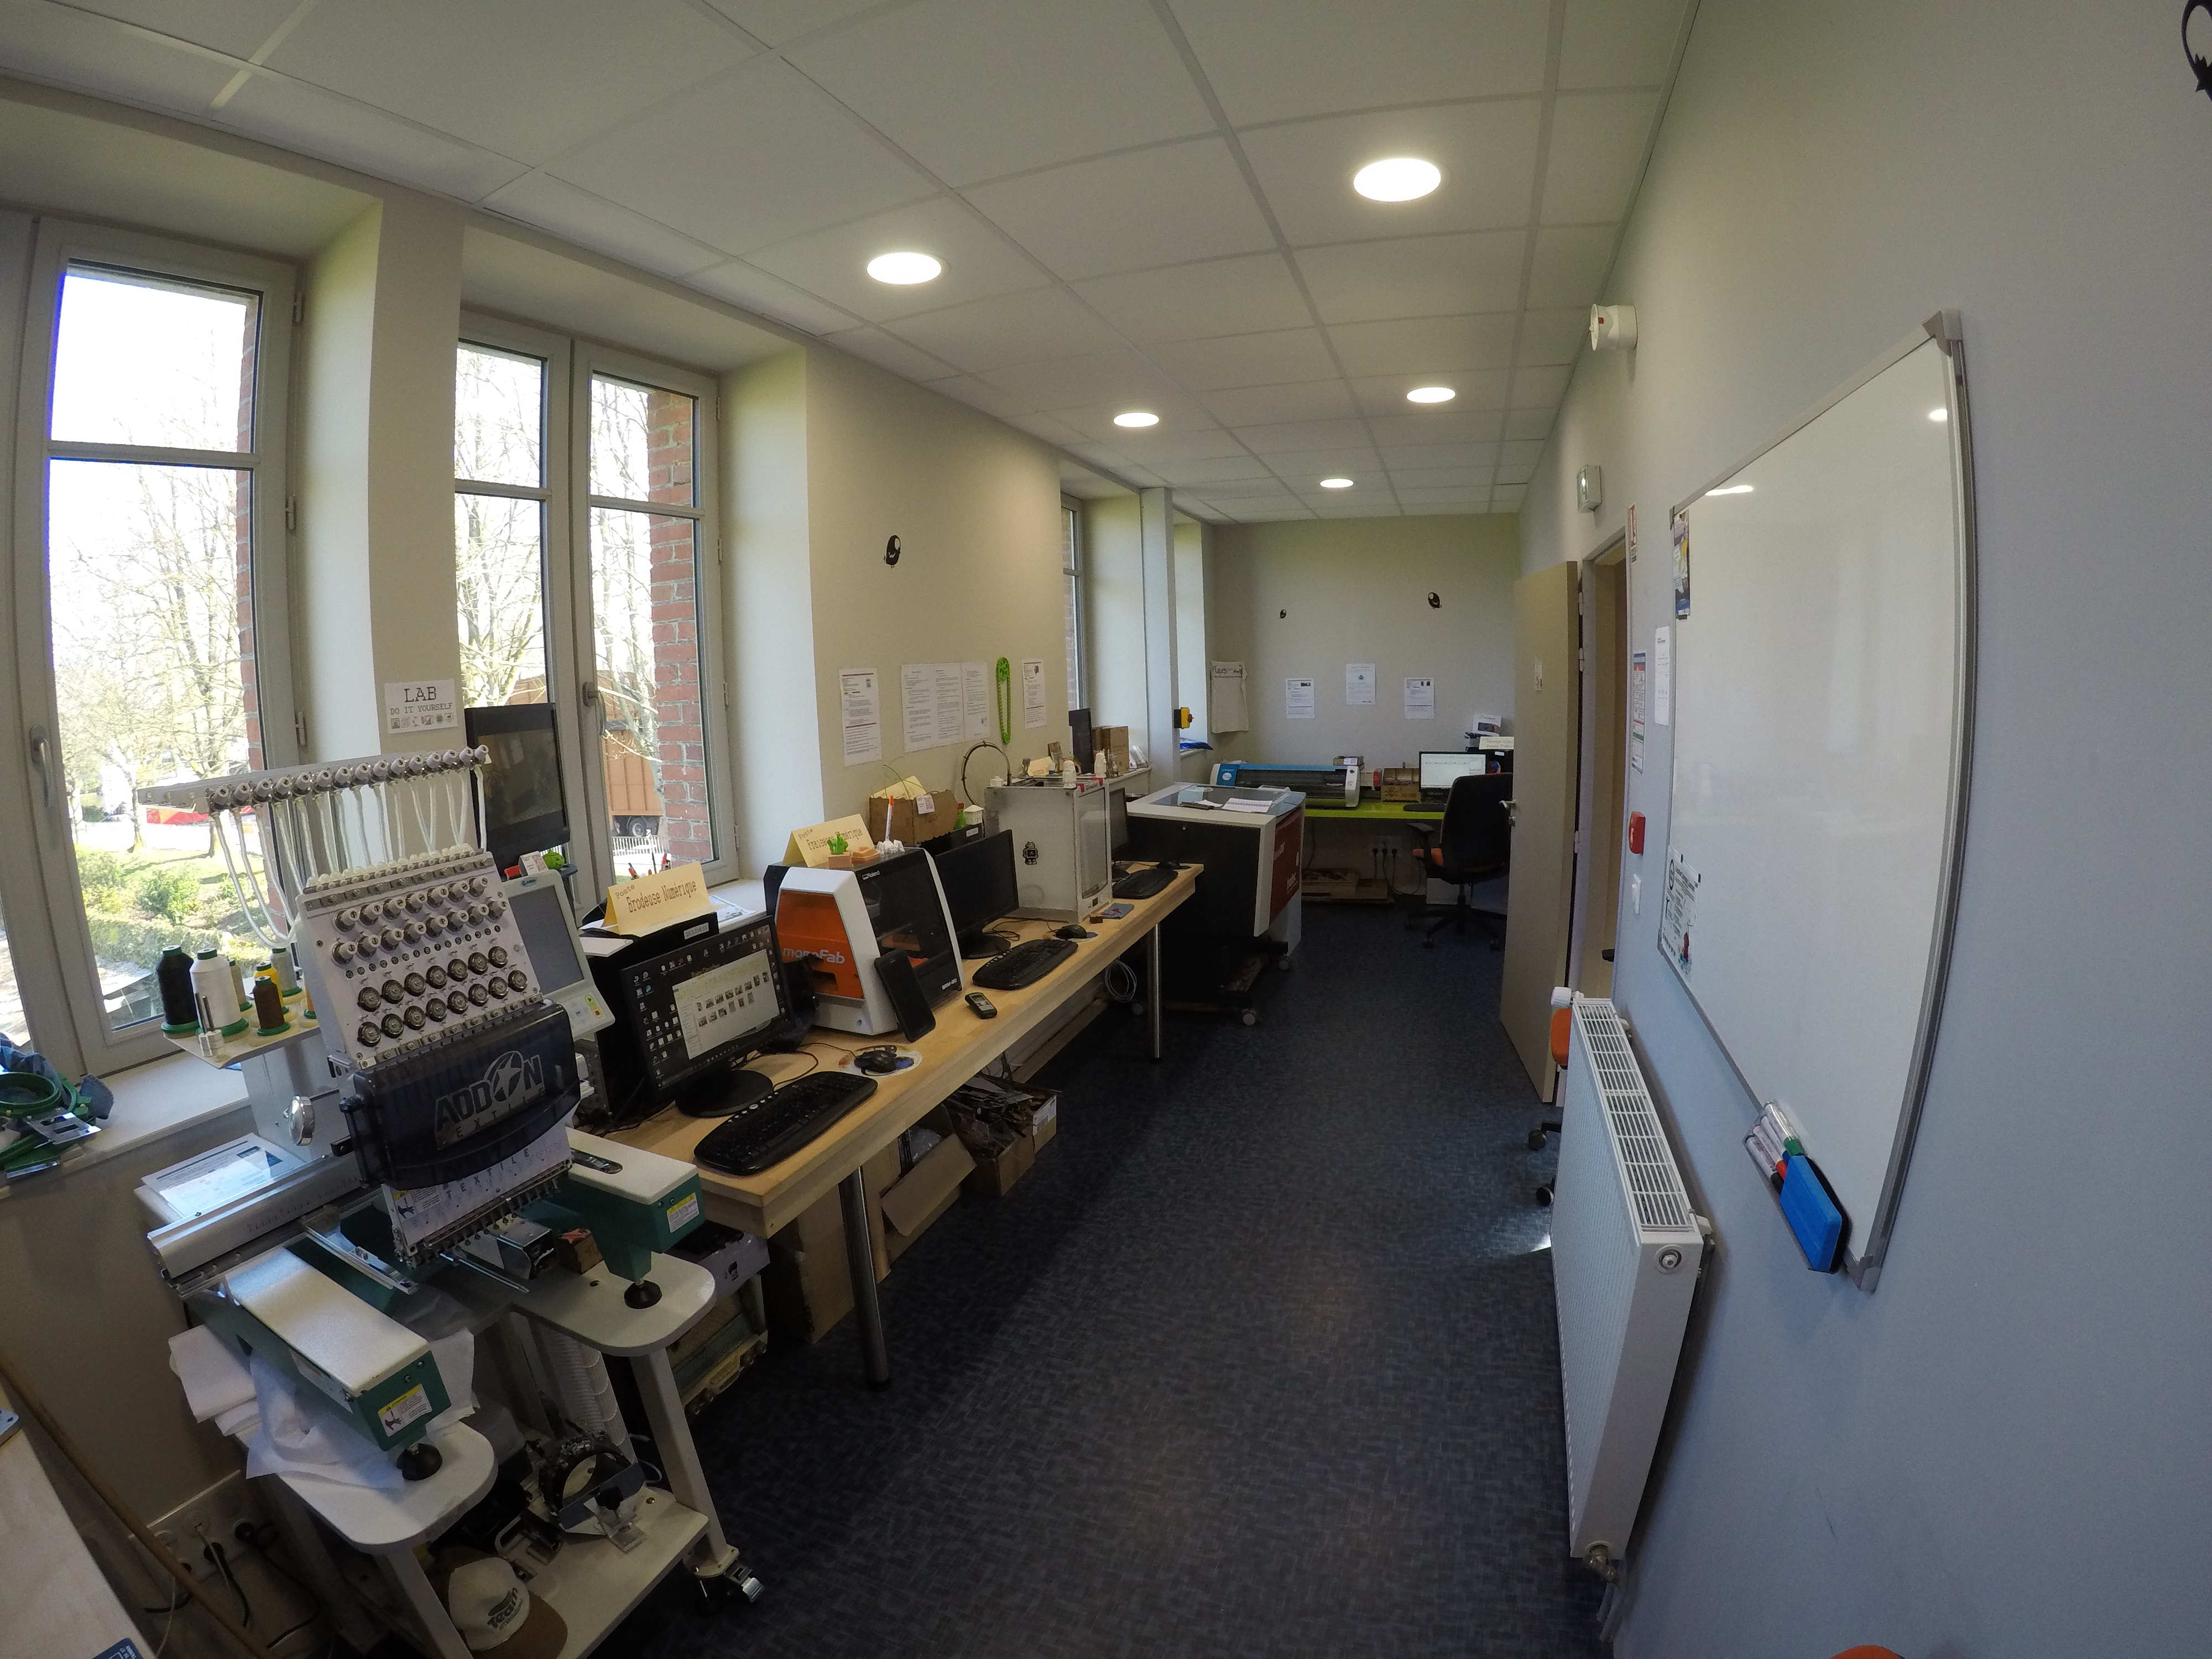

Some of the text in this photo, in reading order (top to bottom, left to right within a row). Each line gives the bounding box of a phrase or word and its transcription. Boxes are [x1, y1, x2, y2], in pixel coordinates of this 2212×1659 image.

[404, 686, 436, 702] LAB
[418, 702, 452, 712] YOURSELF
[798, 828, 813, 840] Poste
[615, 885, 635, 899] Poste
[627, 880, 697, 913] Brodeuse Numérique
[445, 1148, 530, 1199] TEXTILE
